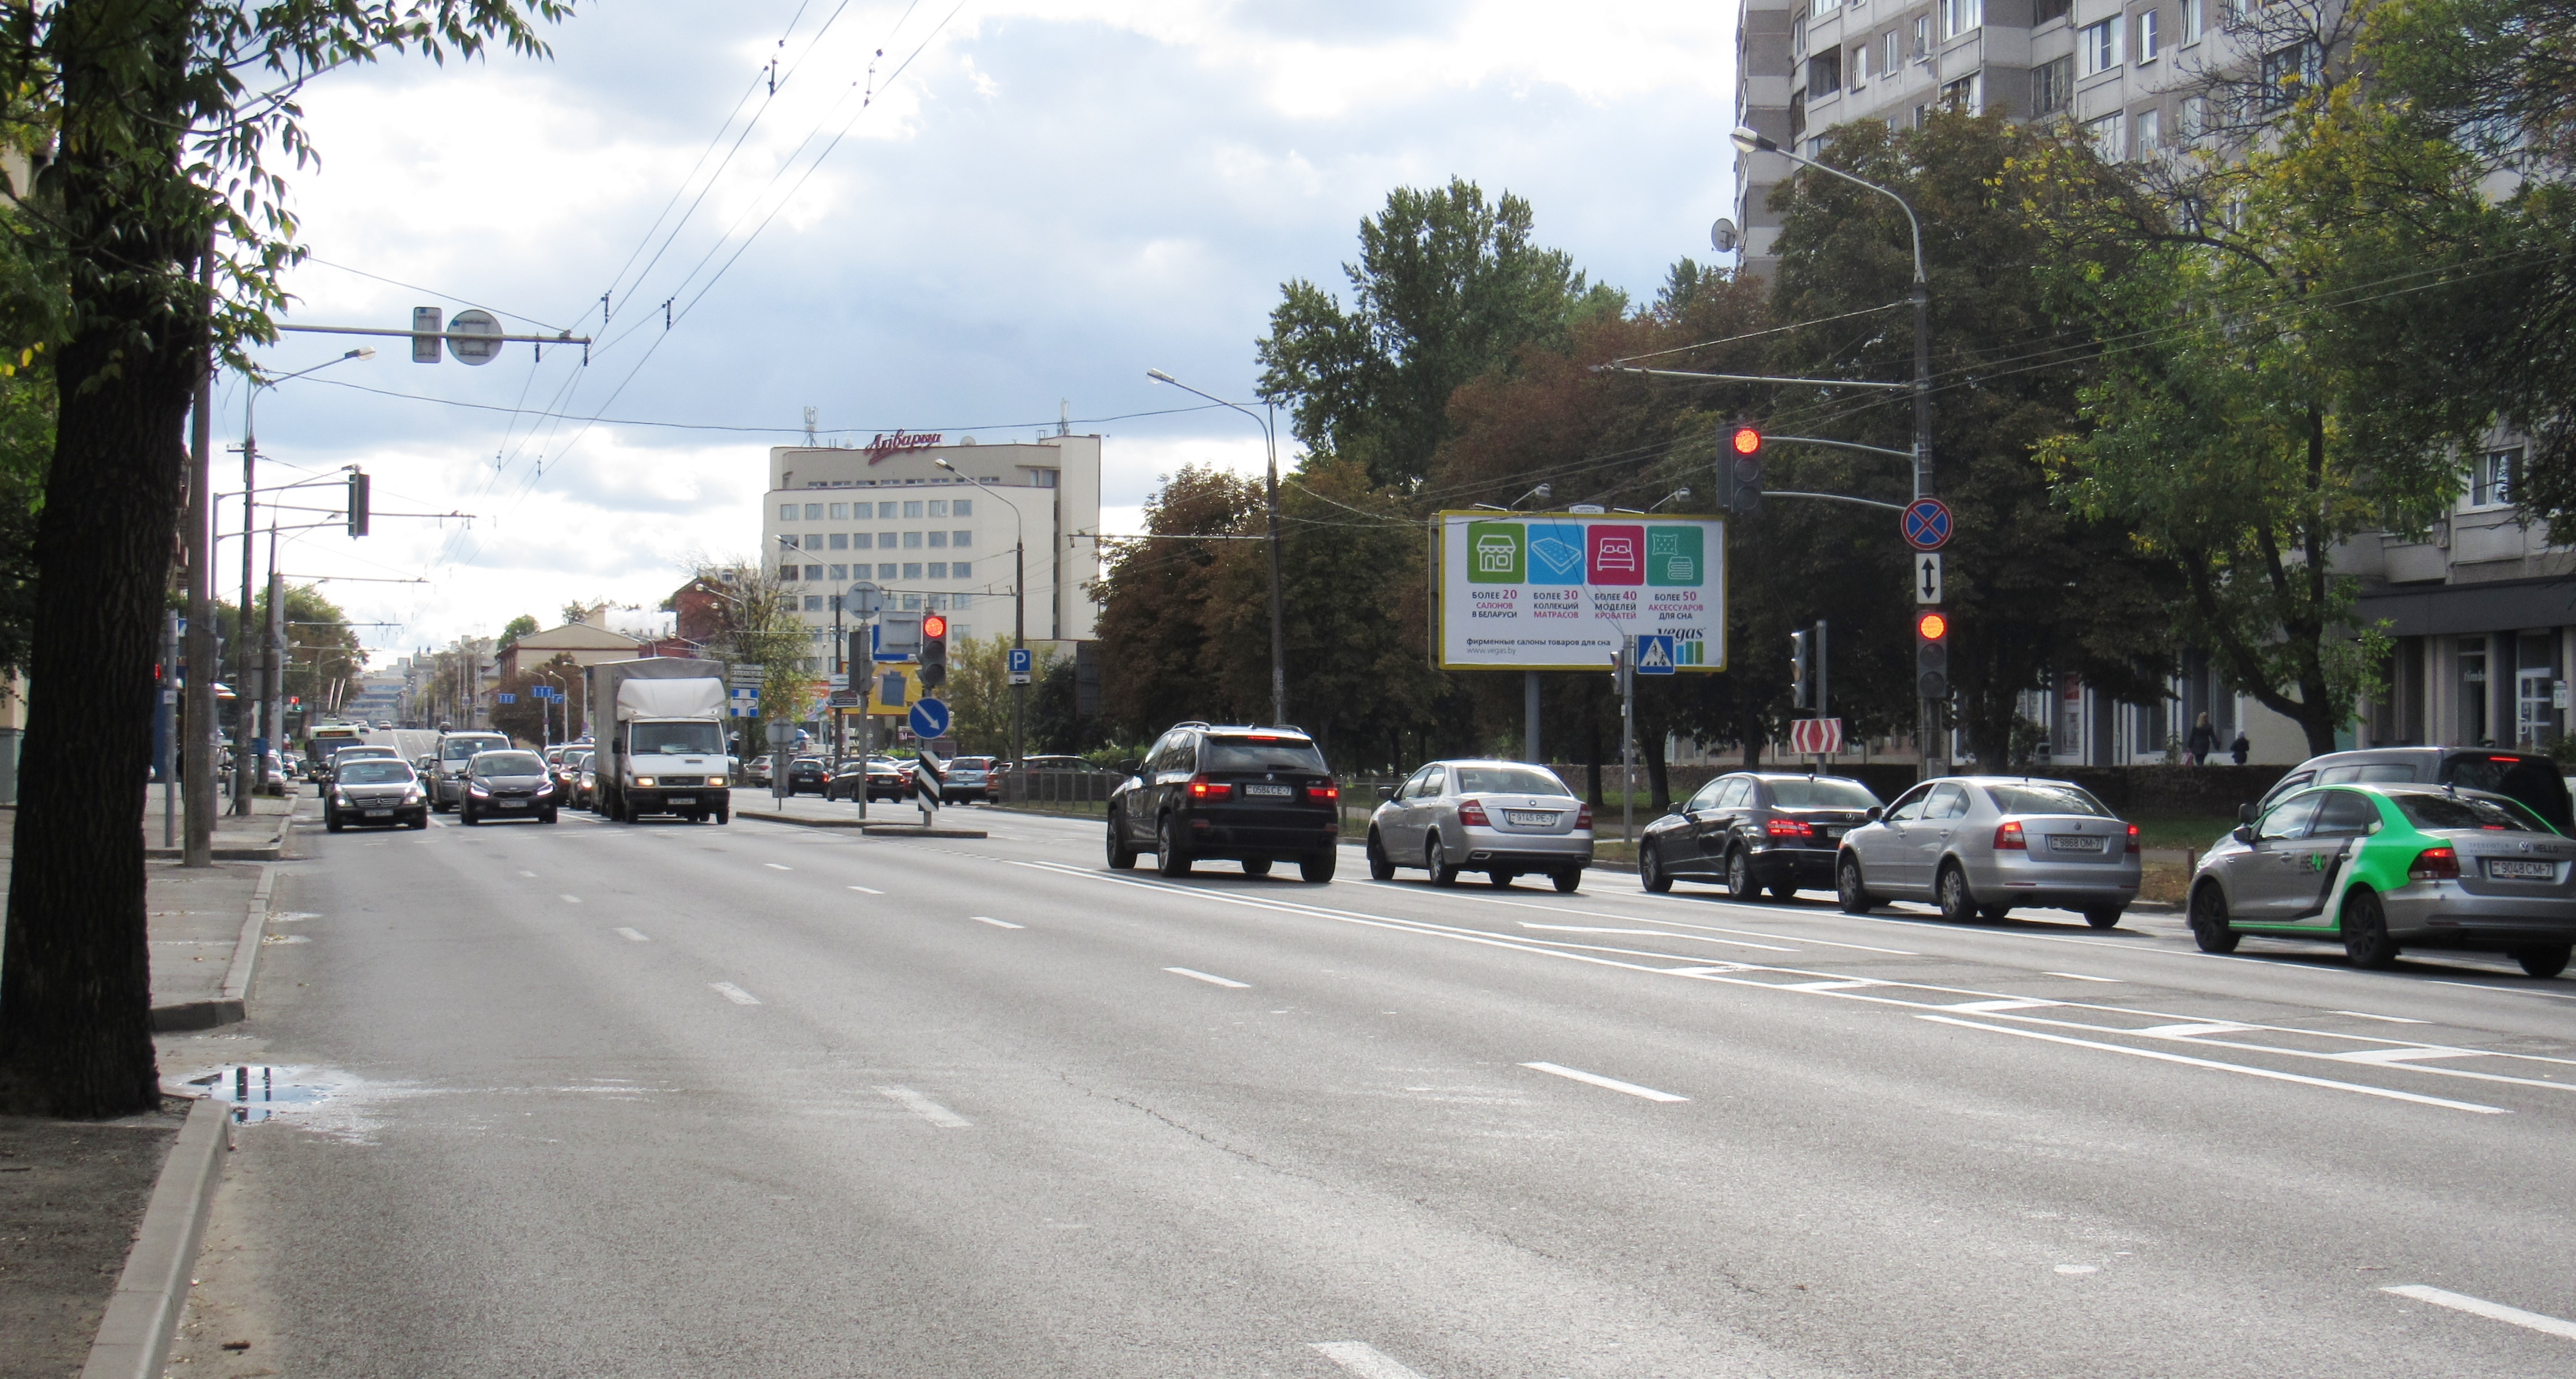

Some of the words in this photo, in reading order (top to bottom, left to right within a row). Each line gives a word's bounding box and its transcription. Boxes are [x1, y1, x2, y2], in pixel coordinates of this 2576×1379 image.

[1472, 591, 1499, 599] БОЛЕЕ
[1502, 590, 1517, 599] 20
[1563, 590, 1578, 600] 30
[1622, 591, 1637, 600] 40
[1682, 591, 1697, 601] 50
[1533, 602, 1578, 610] КОЛЛЕКЦИЙ
[1595, 603, 1637, 611] МОДЕЛЕЙ
[1595, 611, 1637, 619] КРОВАТЕЙ
[1467, 637, 1515, 646] фирменные
[1467, 647, 1517, 655] www.vegas.by
[1014, 652, 1026, 669] P
[1517, 814, 1533, 822] 9145
[2060, 838, 2078, 847] 9868
[2533, 844, 2558, 853] HELLO
[2502, 862, 2524, 874] 9048
